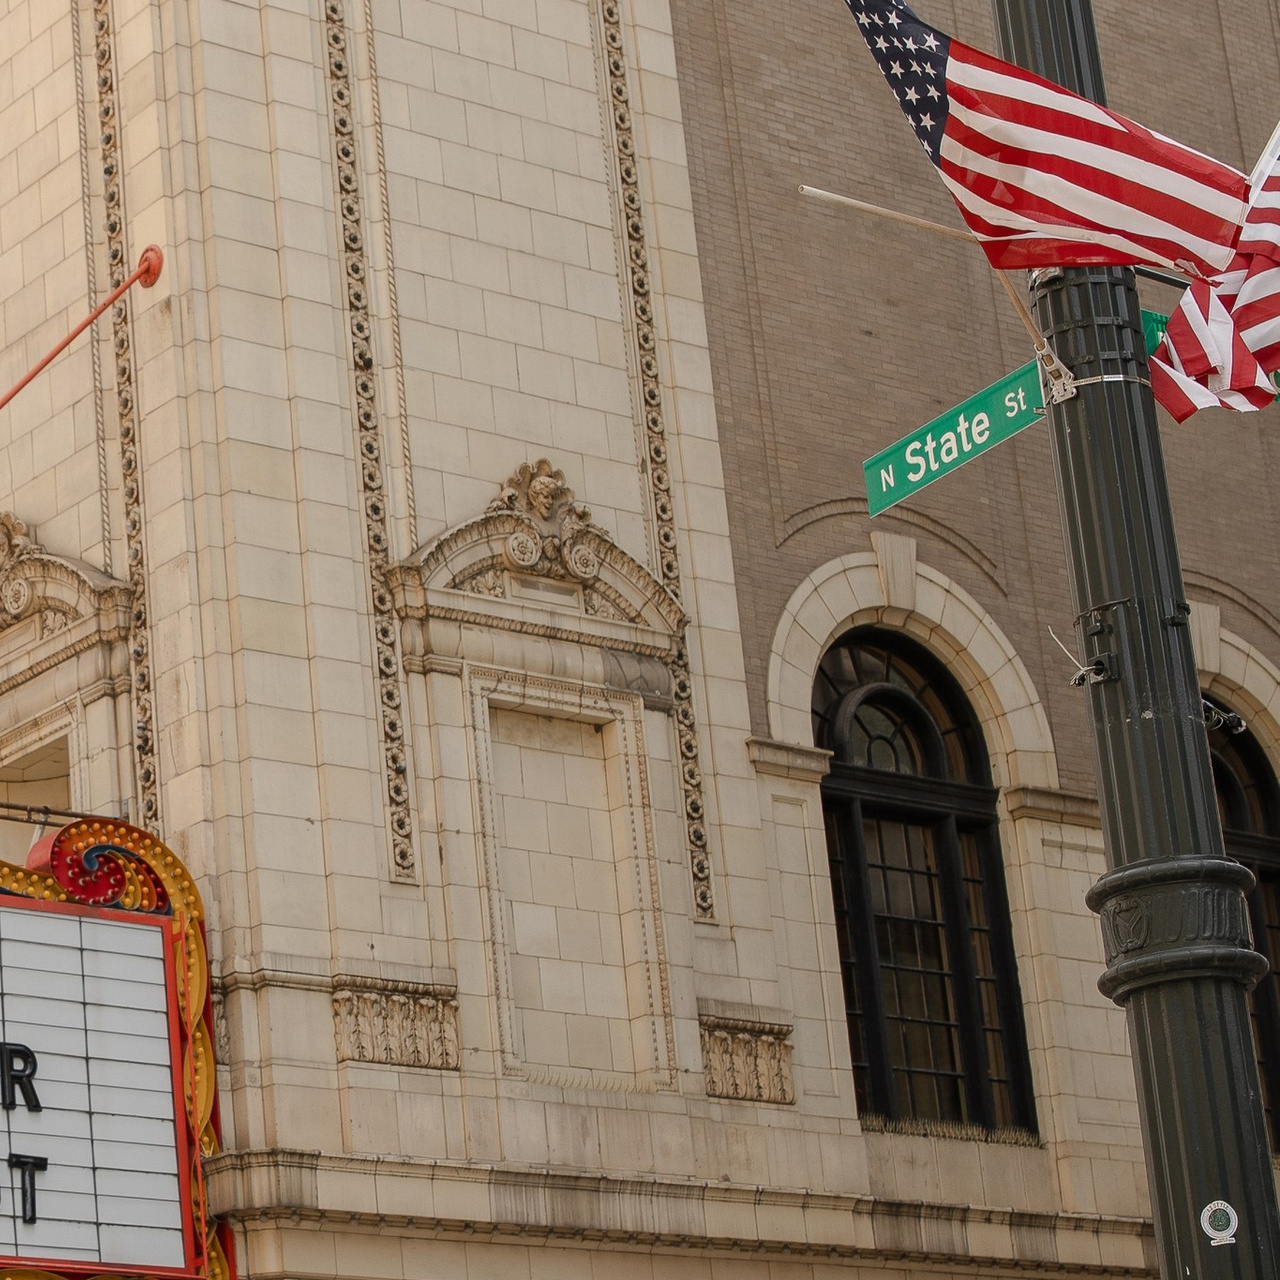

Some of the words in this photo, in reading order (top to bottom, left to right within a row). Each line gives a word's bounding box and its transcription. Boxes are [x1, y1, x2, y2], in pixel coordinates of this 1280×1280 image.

[880, 464, 895, 492] N
[905, 411, 991, 482] State
[1004, 387, 1027, 418] St
